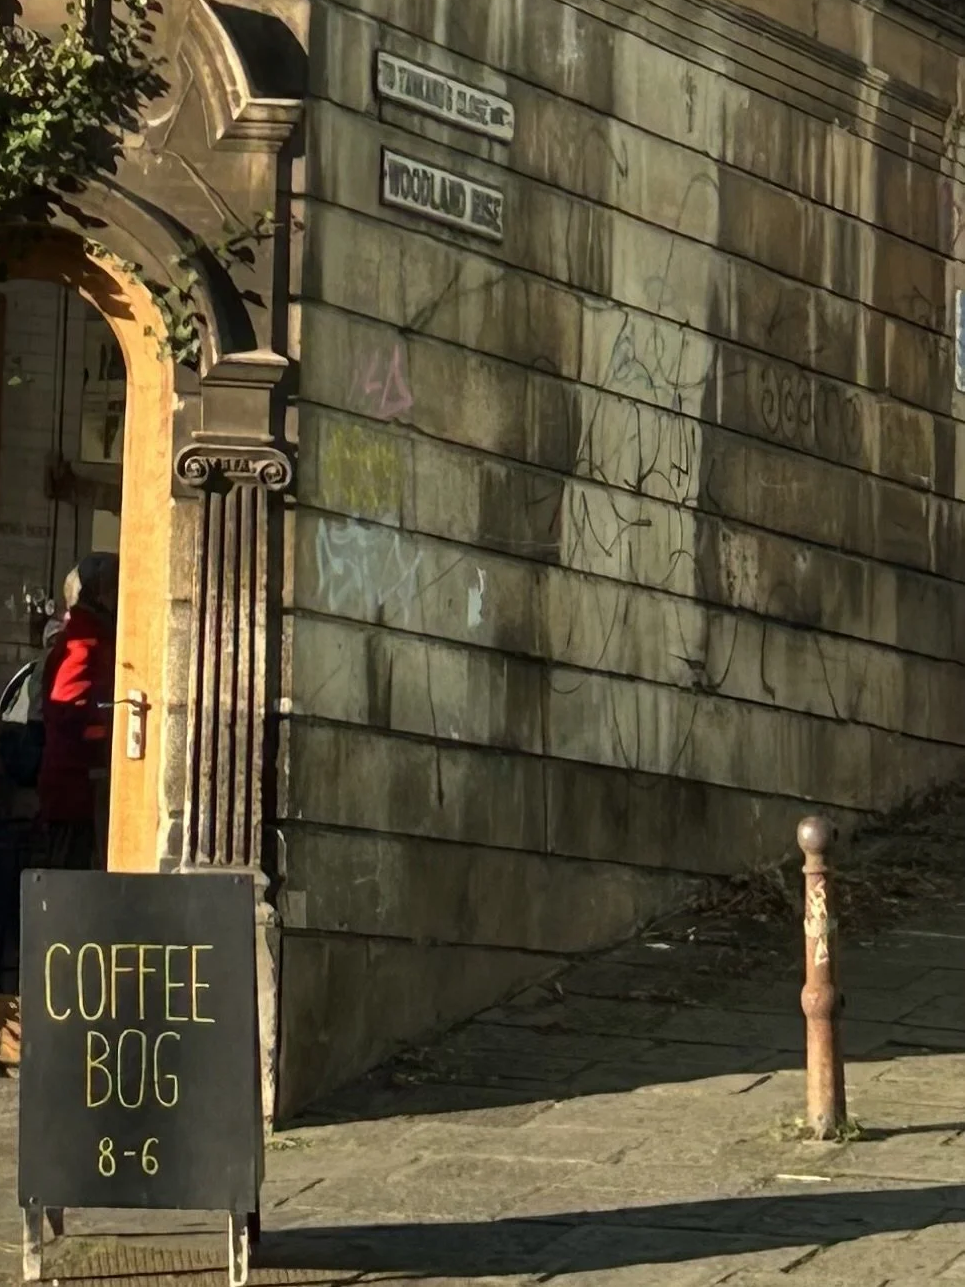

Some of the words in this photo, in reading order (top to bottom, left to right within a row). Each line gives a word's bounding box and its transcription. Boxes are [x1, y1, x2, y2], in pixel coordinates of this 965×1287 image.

[44, 942, 215, 1023] COFFEE
[86, 1028, 181, 1109] BOG
[98, 1136, 159, 1177] 8-6
